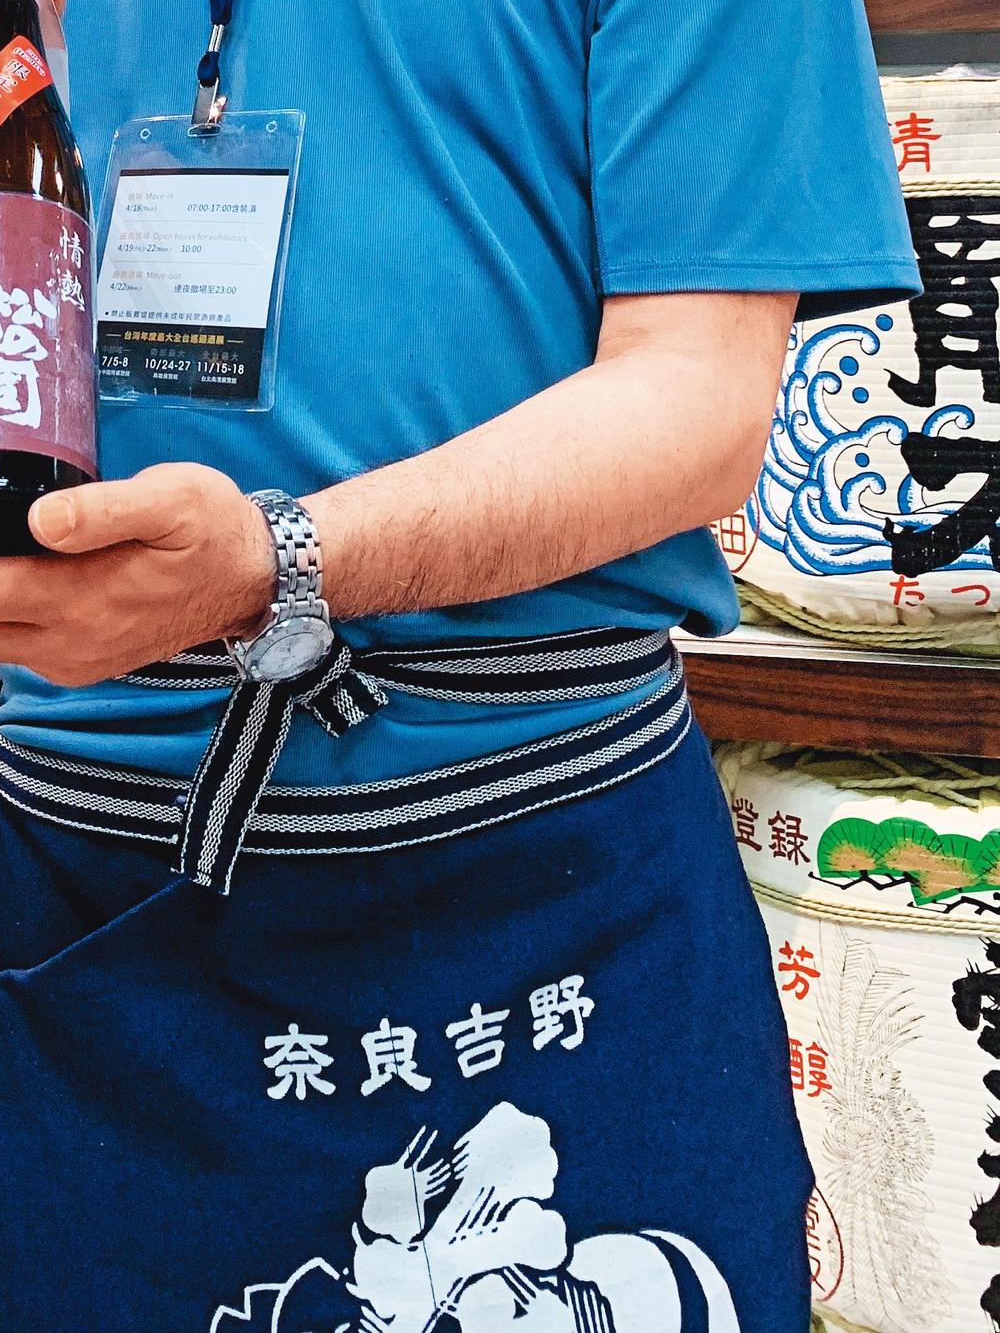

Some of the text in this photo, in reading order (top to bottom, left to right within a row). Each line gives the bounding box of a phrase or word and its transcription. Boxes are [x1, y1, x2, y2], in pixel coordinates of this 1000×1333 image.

[101, 355, 129, 367] 7/5-8
[145, 358, 191, 371] 10/24-27
[198, 361, 245, 375] 11/15-18
[731, 797, 811, 867] 登録
[262, 973, 596, 1101] 奈良吉野
